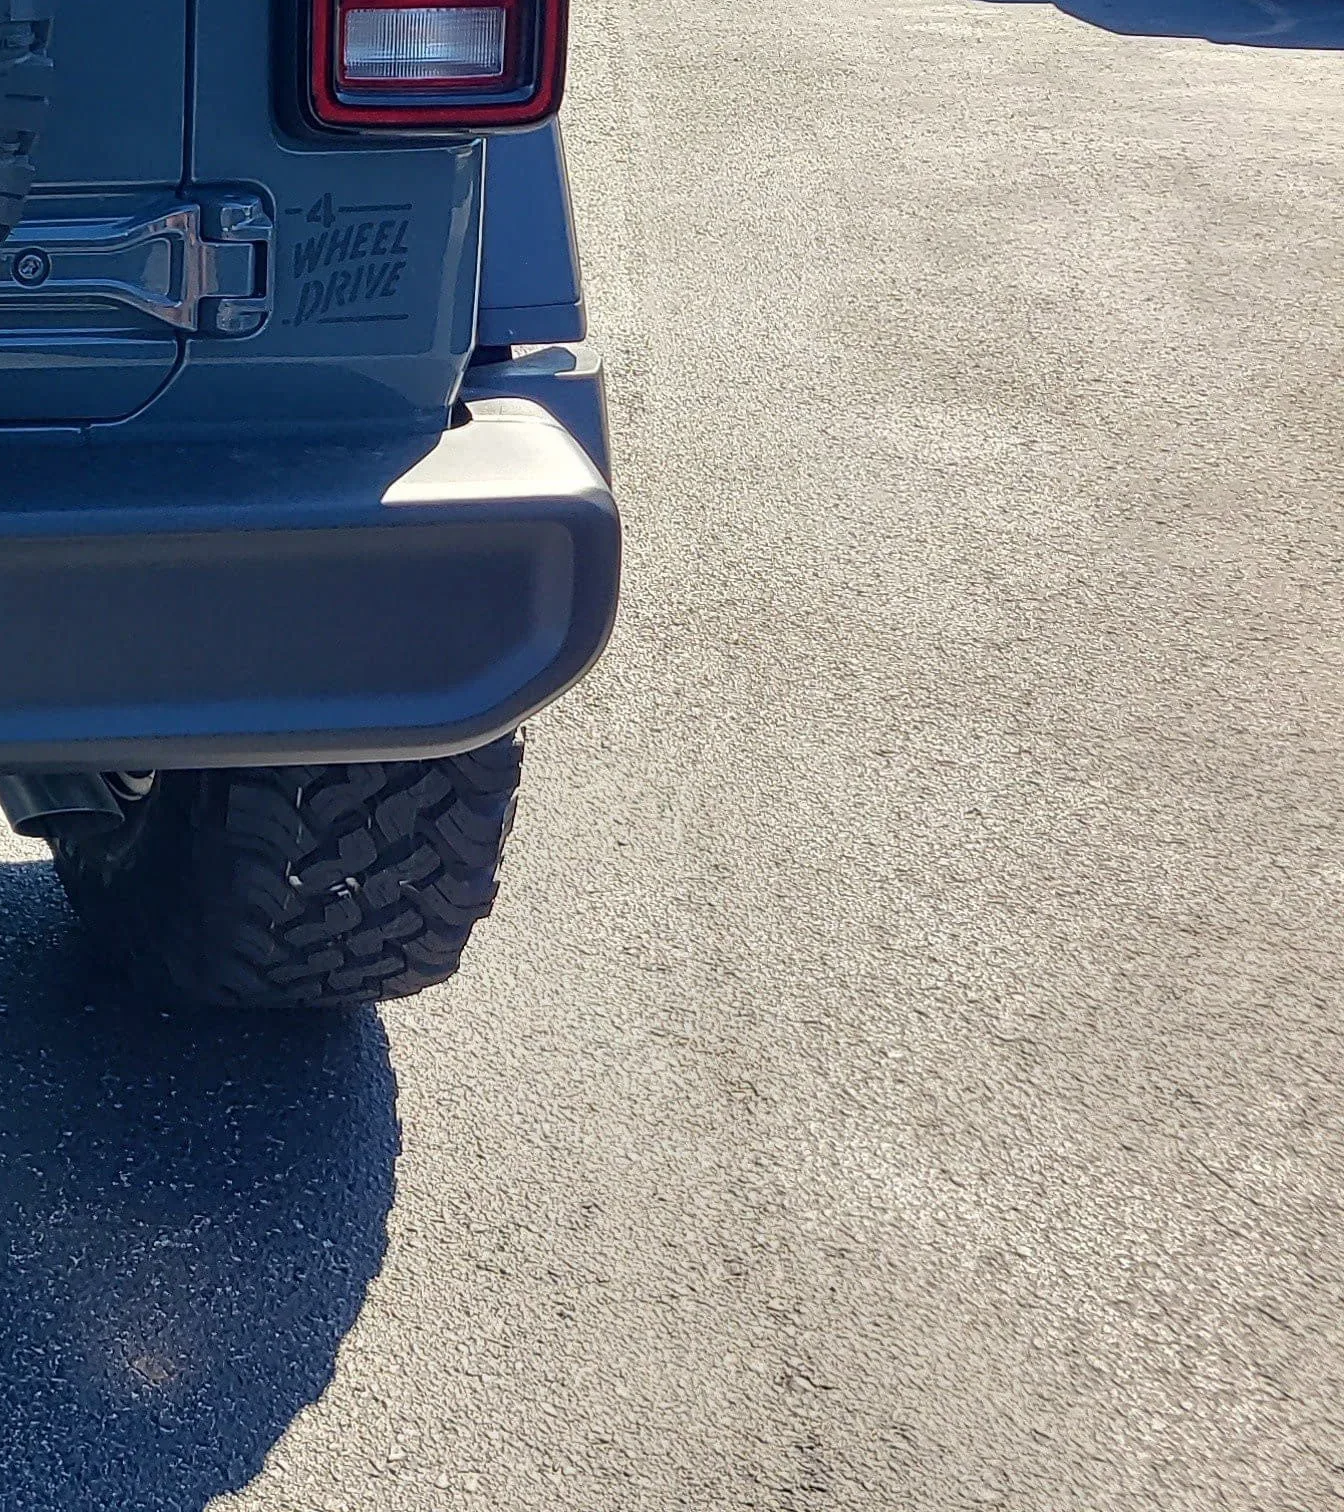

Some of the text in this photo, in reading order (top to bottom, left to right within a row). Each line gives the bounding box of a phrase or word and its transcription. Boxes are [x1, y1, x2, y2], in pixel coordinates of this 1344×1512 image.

[305, 193, 336, 228] 4
[293, 220, 410, 280] WHEEL
[299, 261, 408, 323] DRIVE
